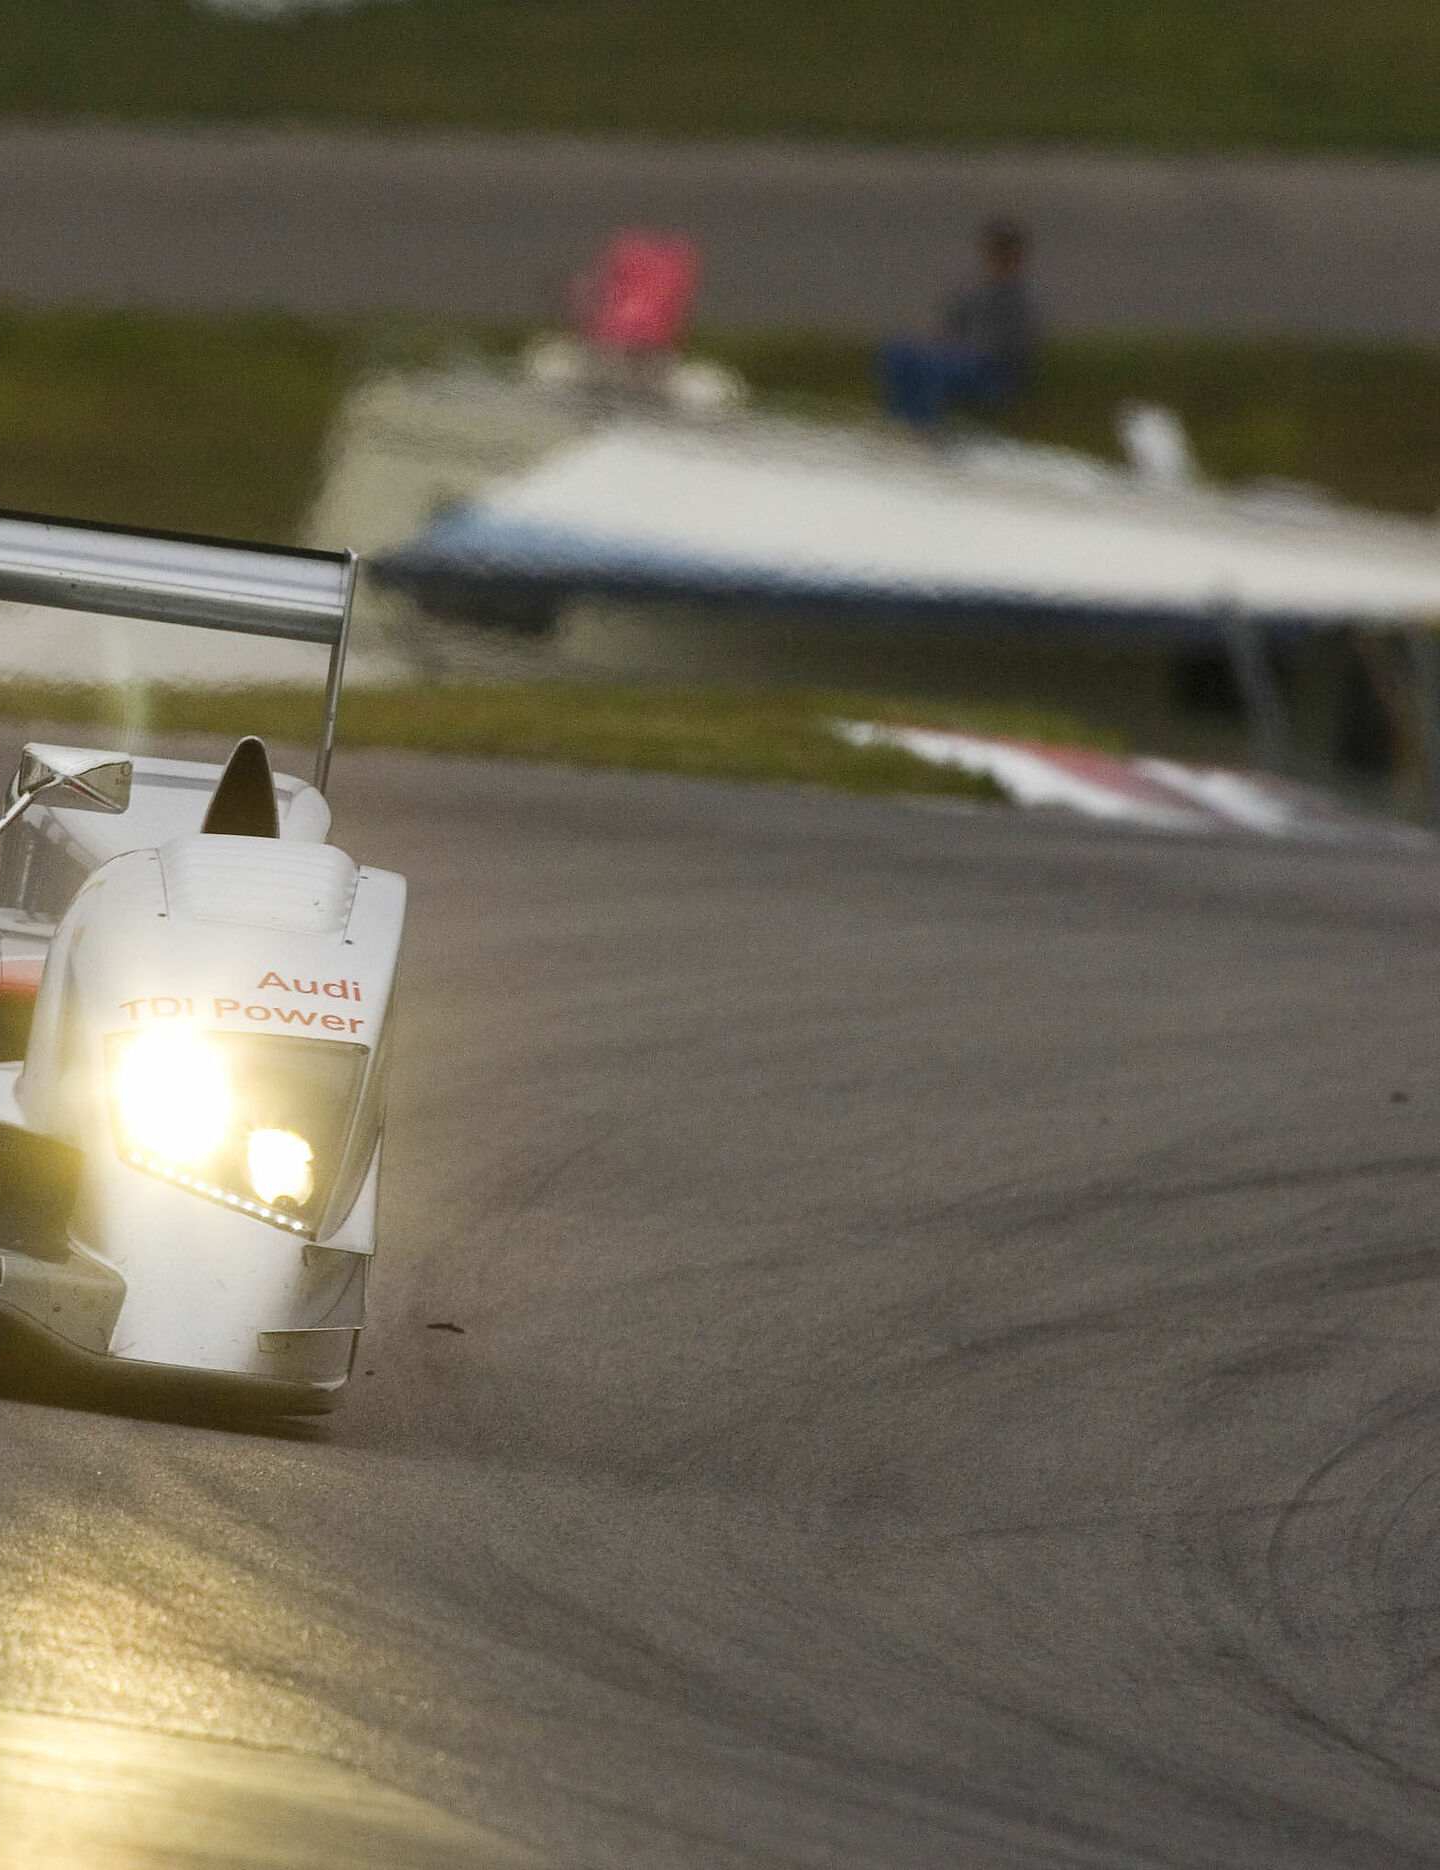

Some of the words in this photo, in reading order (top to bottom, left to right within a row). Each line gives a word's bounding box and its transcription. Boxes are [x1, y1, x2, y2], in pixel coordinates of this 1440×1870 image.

[257, 971, 362, 1002] Audi
[119, 996, 196, 1020] TDI
[212, 997, 366, 1034] Power
